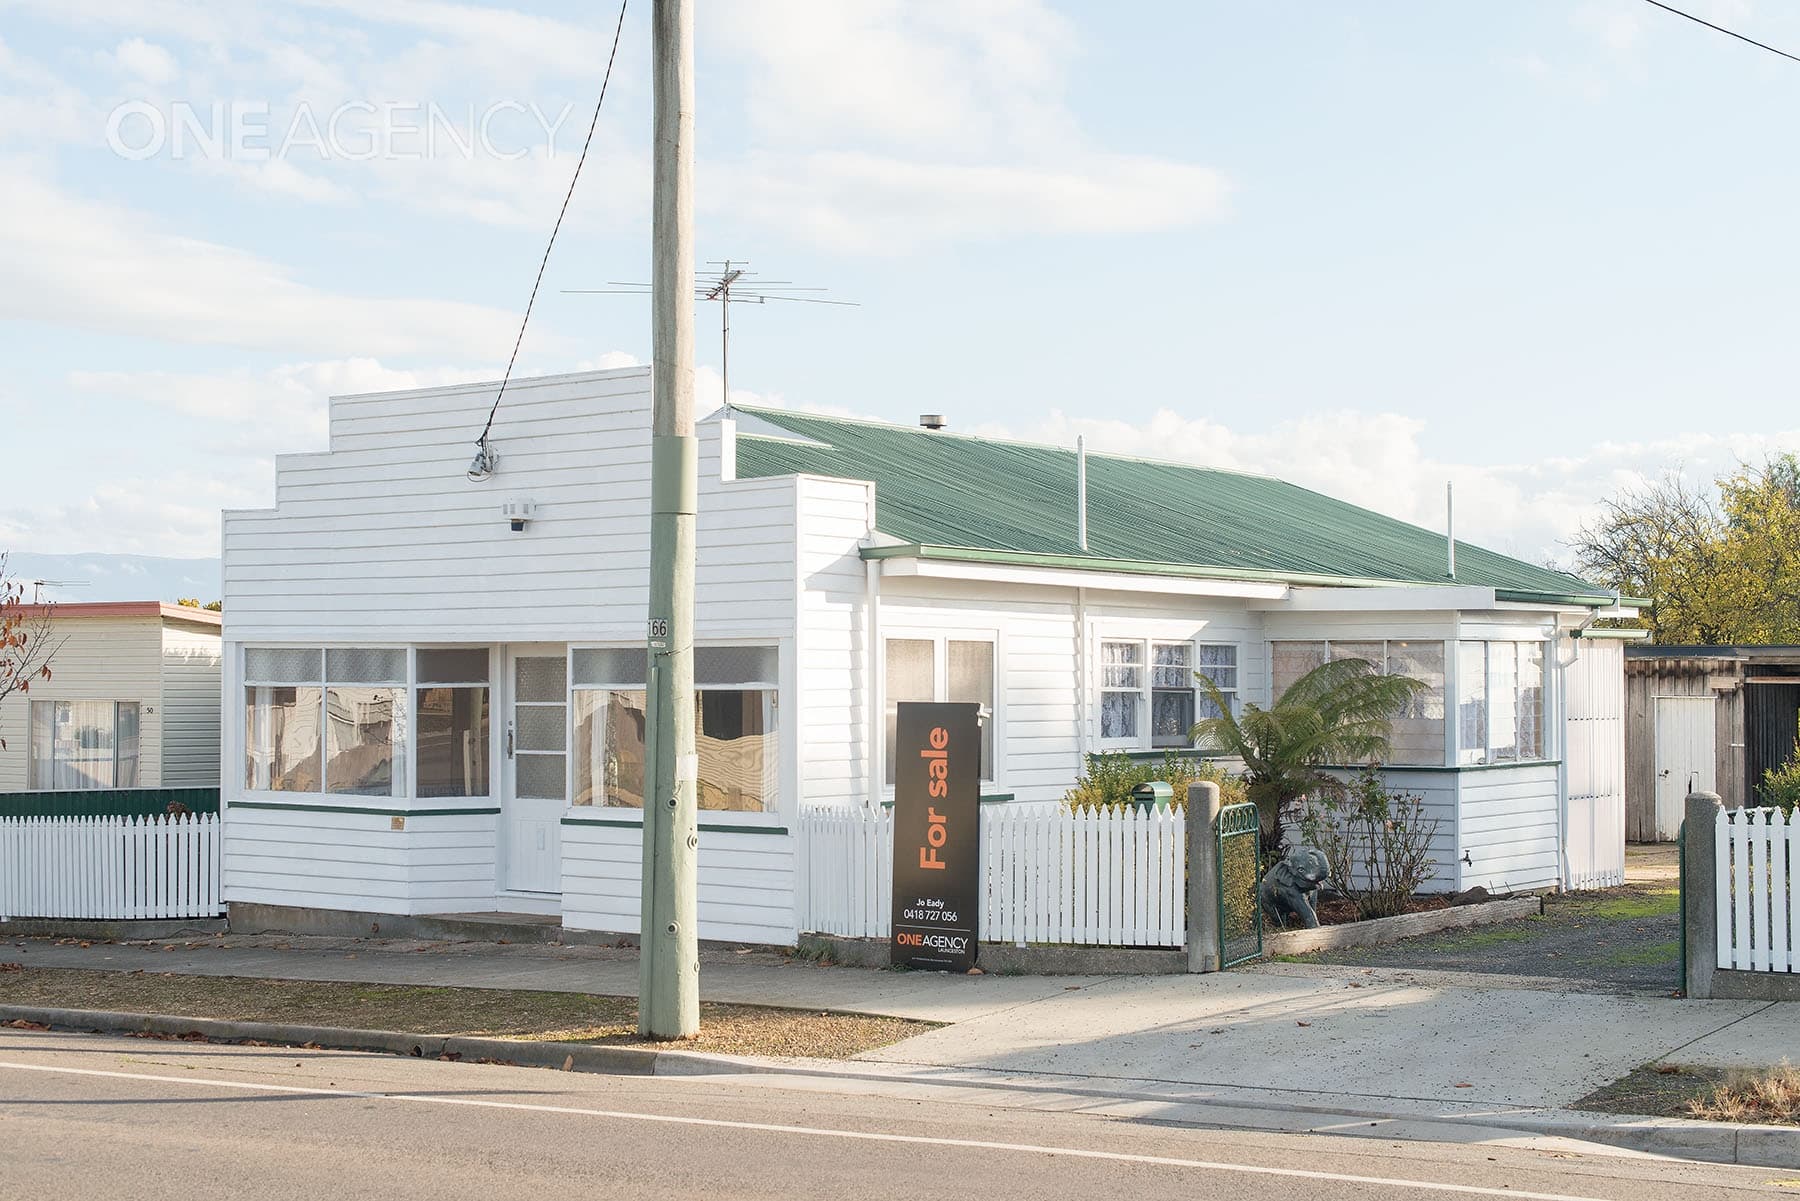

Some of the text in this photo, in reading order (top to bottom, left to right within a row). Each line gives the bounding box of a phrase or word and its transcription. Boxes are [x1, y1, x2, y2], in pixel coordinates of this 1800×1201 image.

[920, 727, 949, 869] For sale
[916, 898, 944, 909] Jo Eady
[903, 909, 958, 922] 0418 727 056
